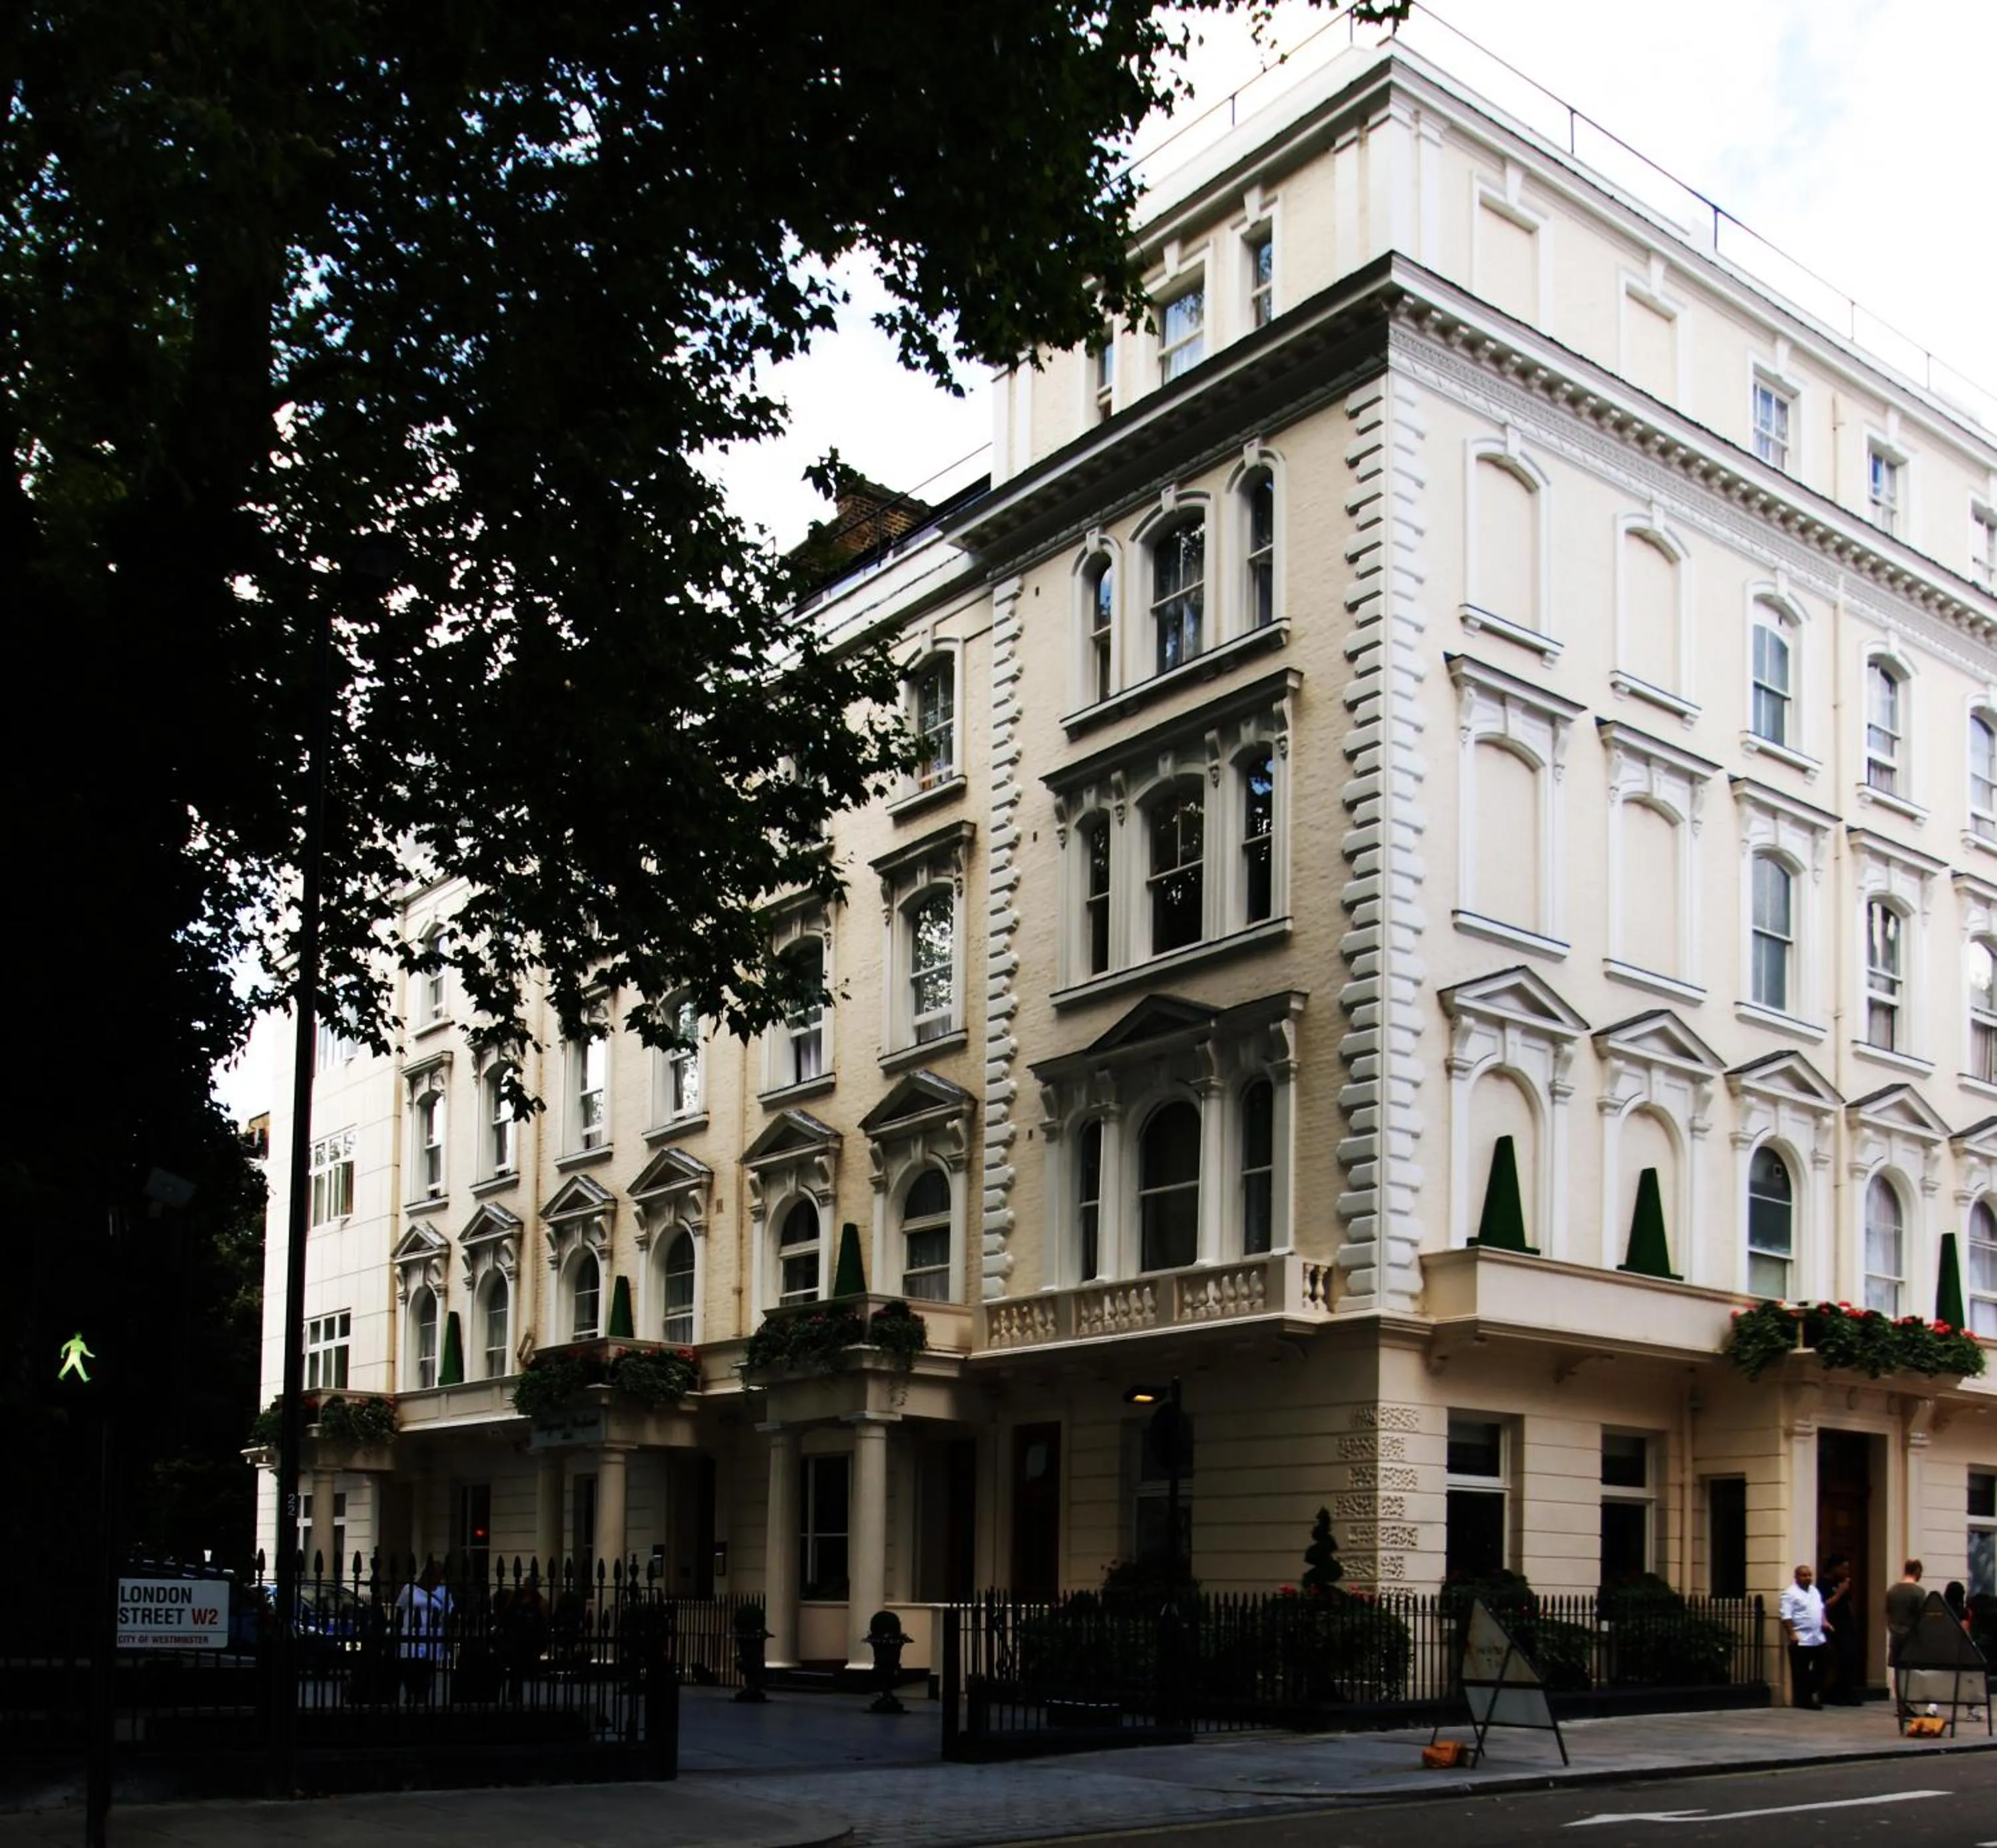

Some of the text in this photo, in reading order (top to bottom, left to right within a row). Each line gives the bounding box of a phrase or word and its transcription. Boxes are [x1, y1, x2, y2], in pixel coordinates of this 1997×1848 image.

[120, 1586, 192, 1604] LONDON
[118, 1607, 218, 1625] STREET W2
[118, 1635, 208, 1644] CITY OF WESTMINSTER
